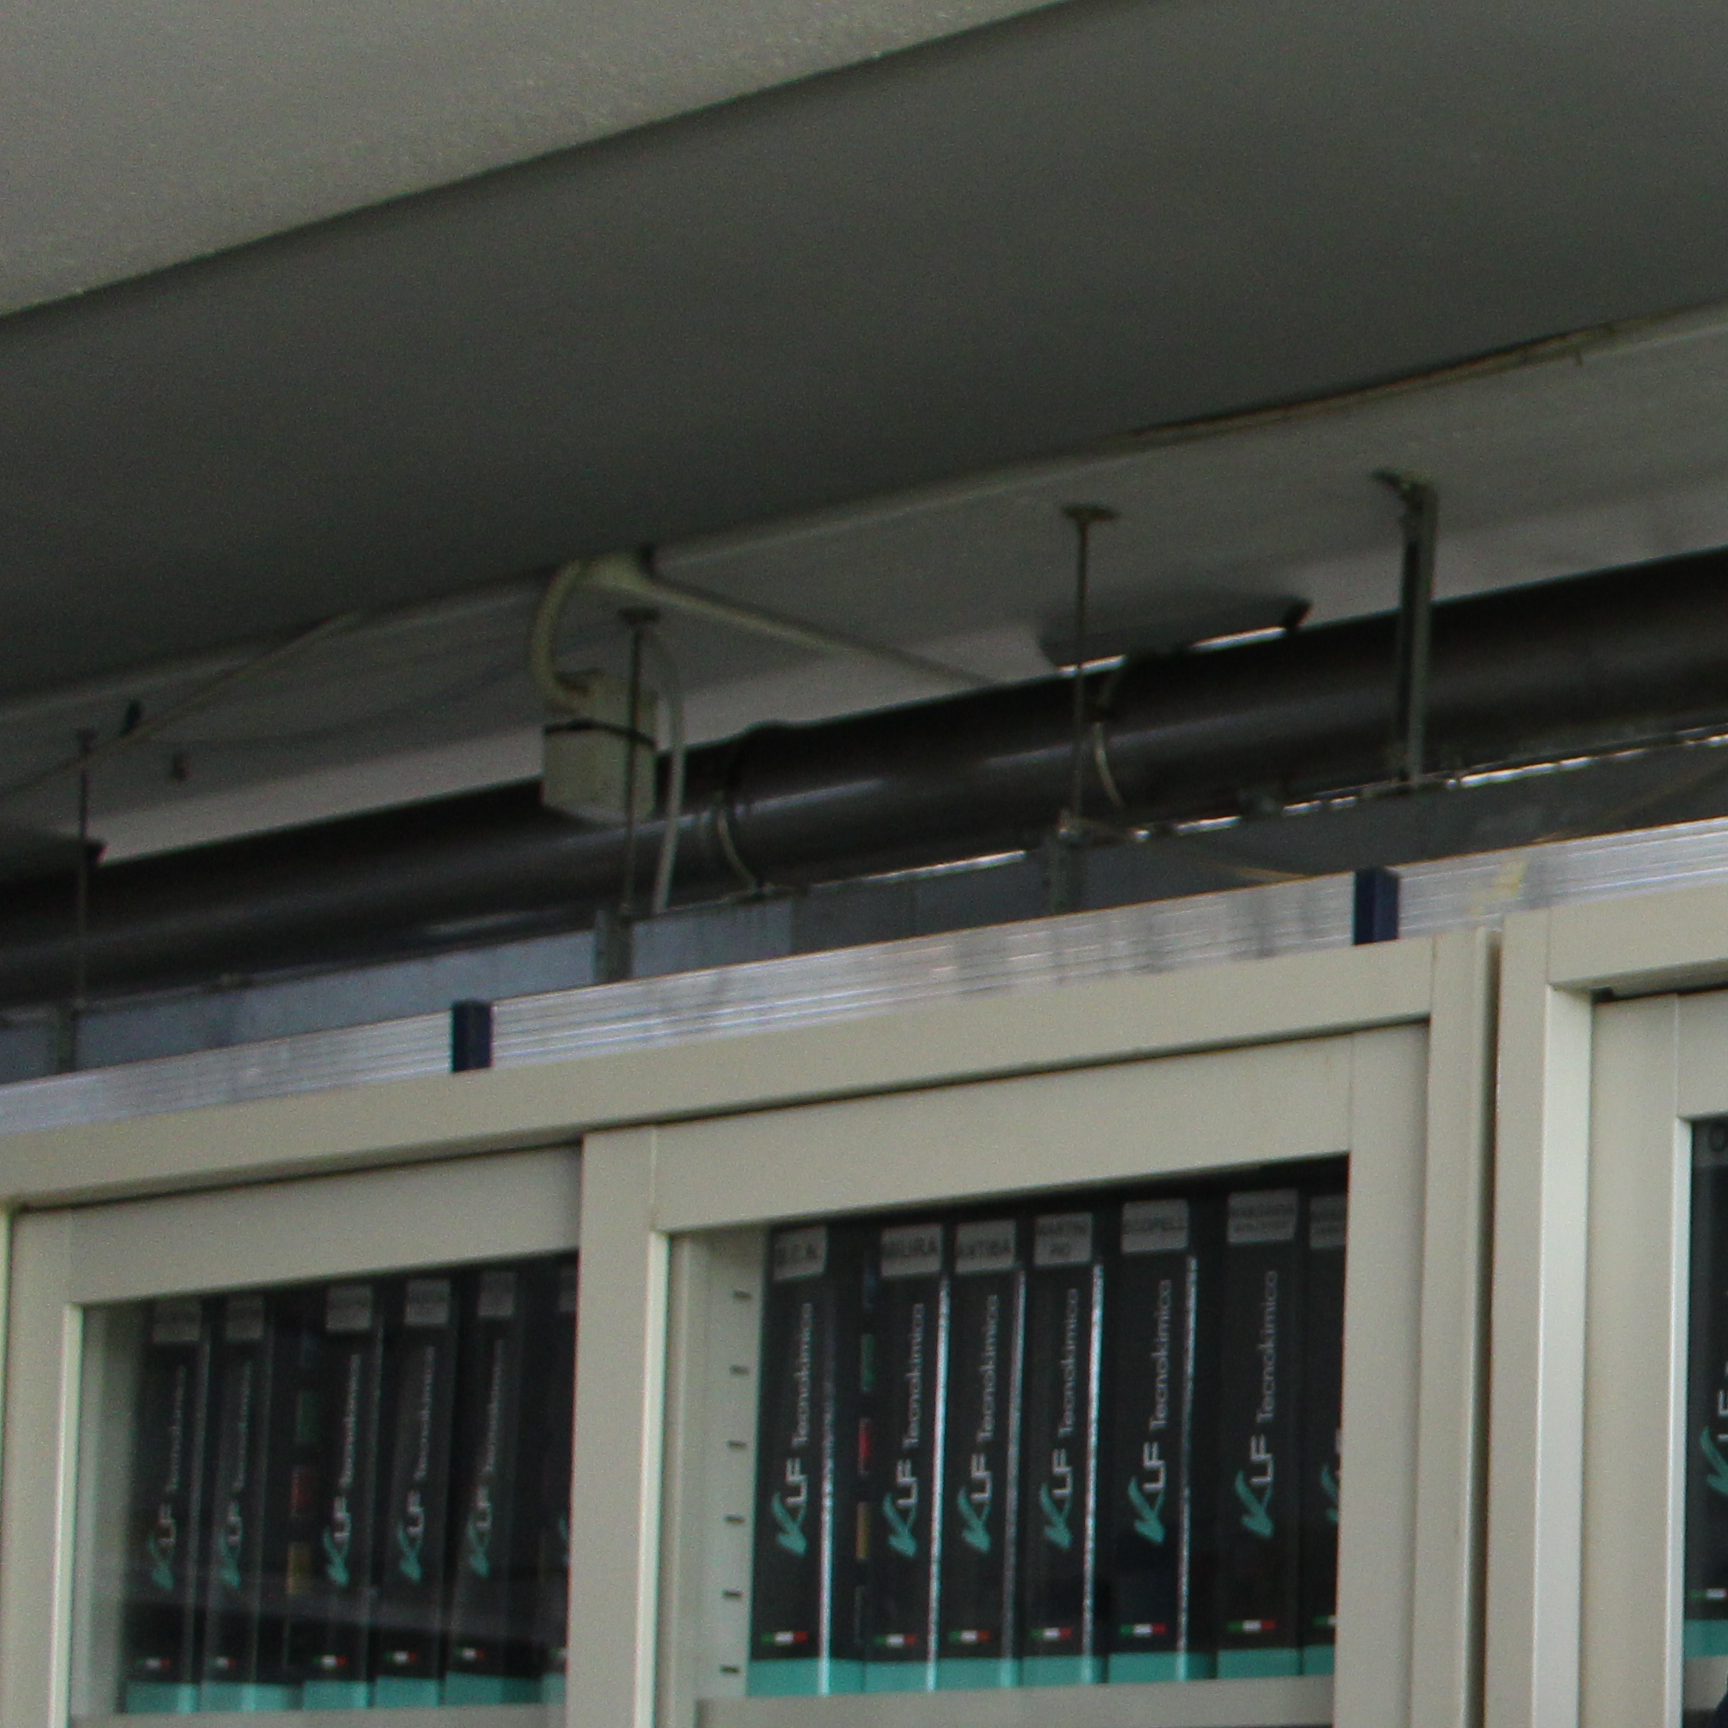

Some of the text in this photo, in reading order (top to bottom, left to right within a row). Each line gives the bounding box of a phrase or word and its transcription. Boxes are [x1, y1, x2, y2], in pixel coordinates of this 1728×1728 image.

[786, 1458, 808, 1508] LF
[896, 1458, 918, 1508] LF
[970, 1453, 993, 1502] LF
[1052, 1448, 1074, 1498] LF
[1142, 1441, 1166, 1493] LF
[1249, 1433, 1274, 1485] LF
